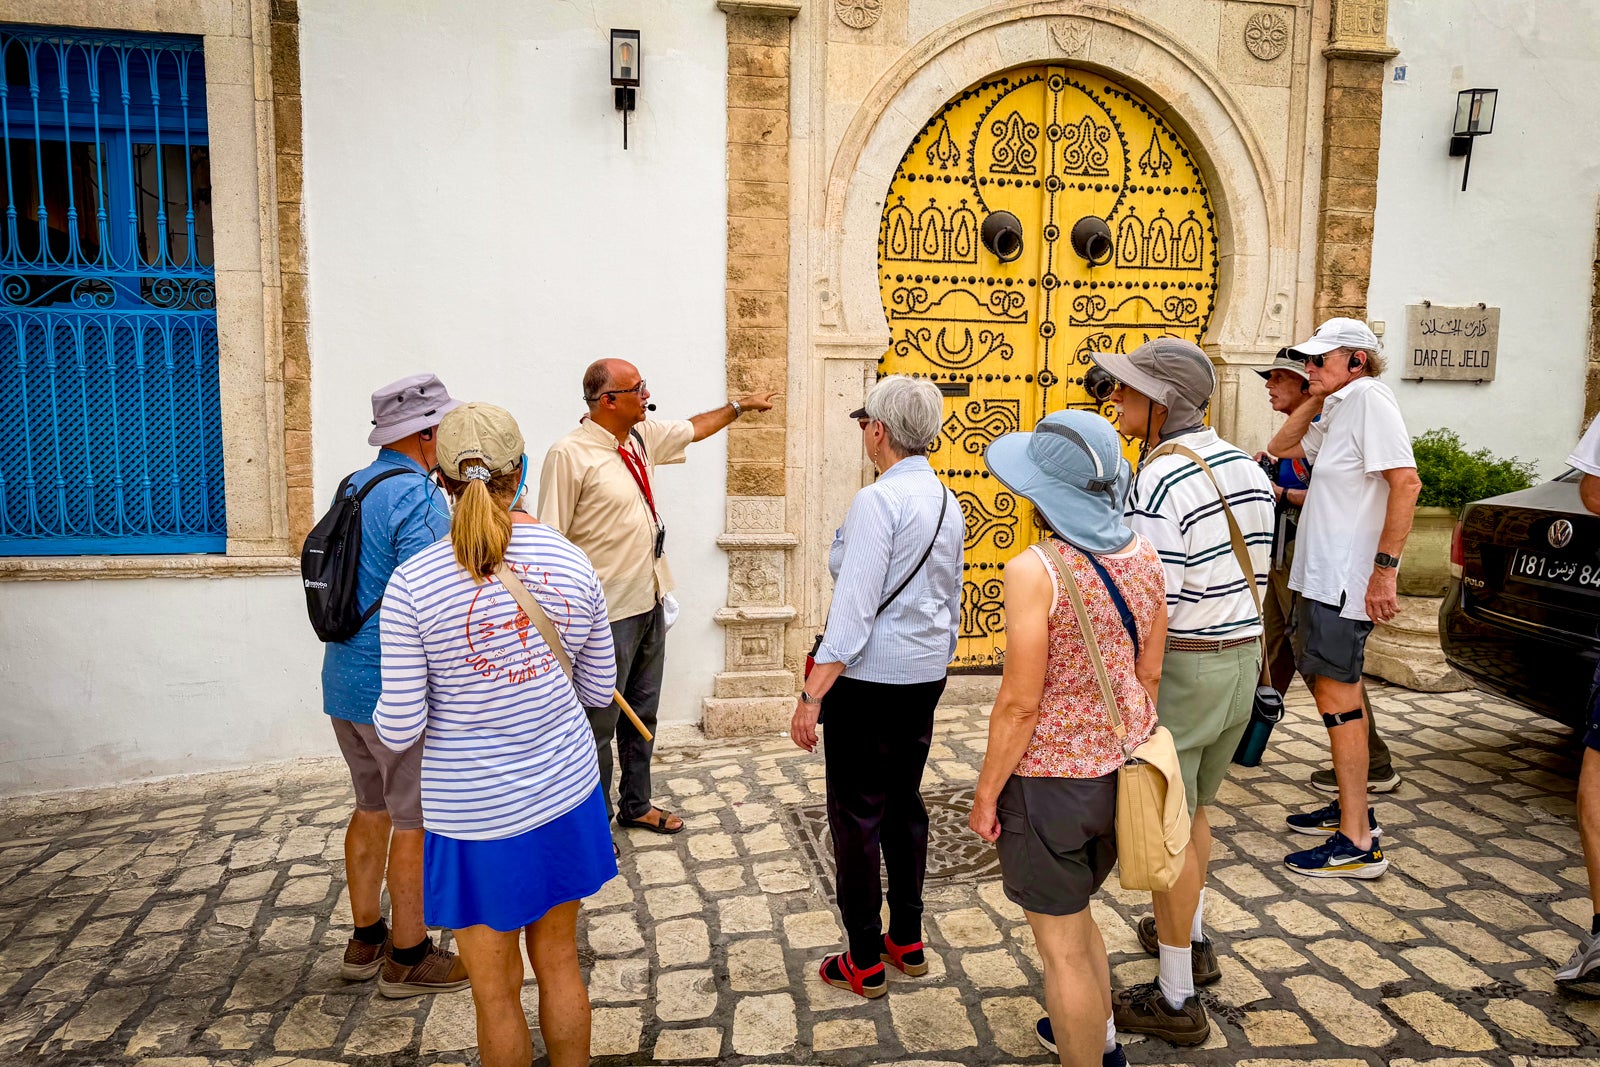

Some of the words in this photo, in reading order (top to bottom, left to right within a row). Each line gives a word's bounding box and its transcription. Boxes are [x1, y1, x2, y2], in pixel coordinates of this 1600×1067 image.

[1413, 348, 1438, 367] DAR
[1440, 349, 1455, 367] EL
[1519, 554, 1546, 577] 181
[1547, 560, 1578, 581] تونس
[1464, 576, 1485, 588] POLO
